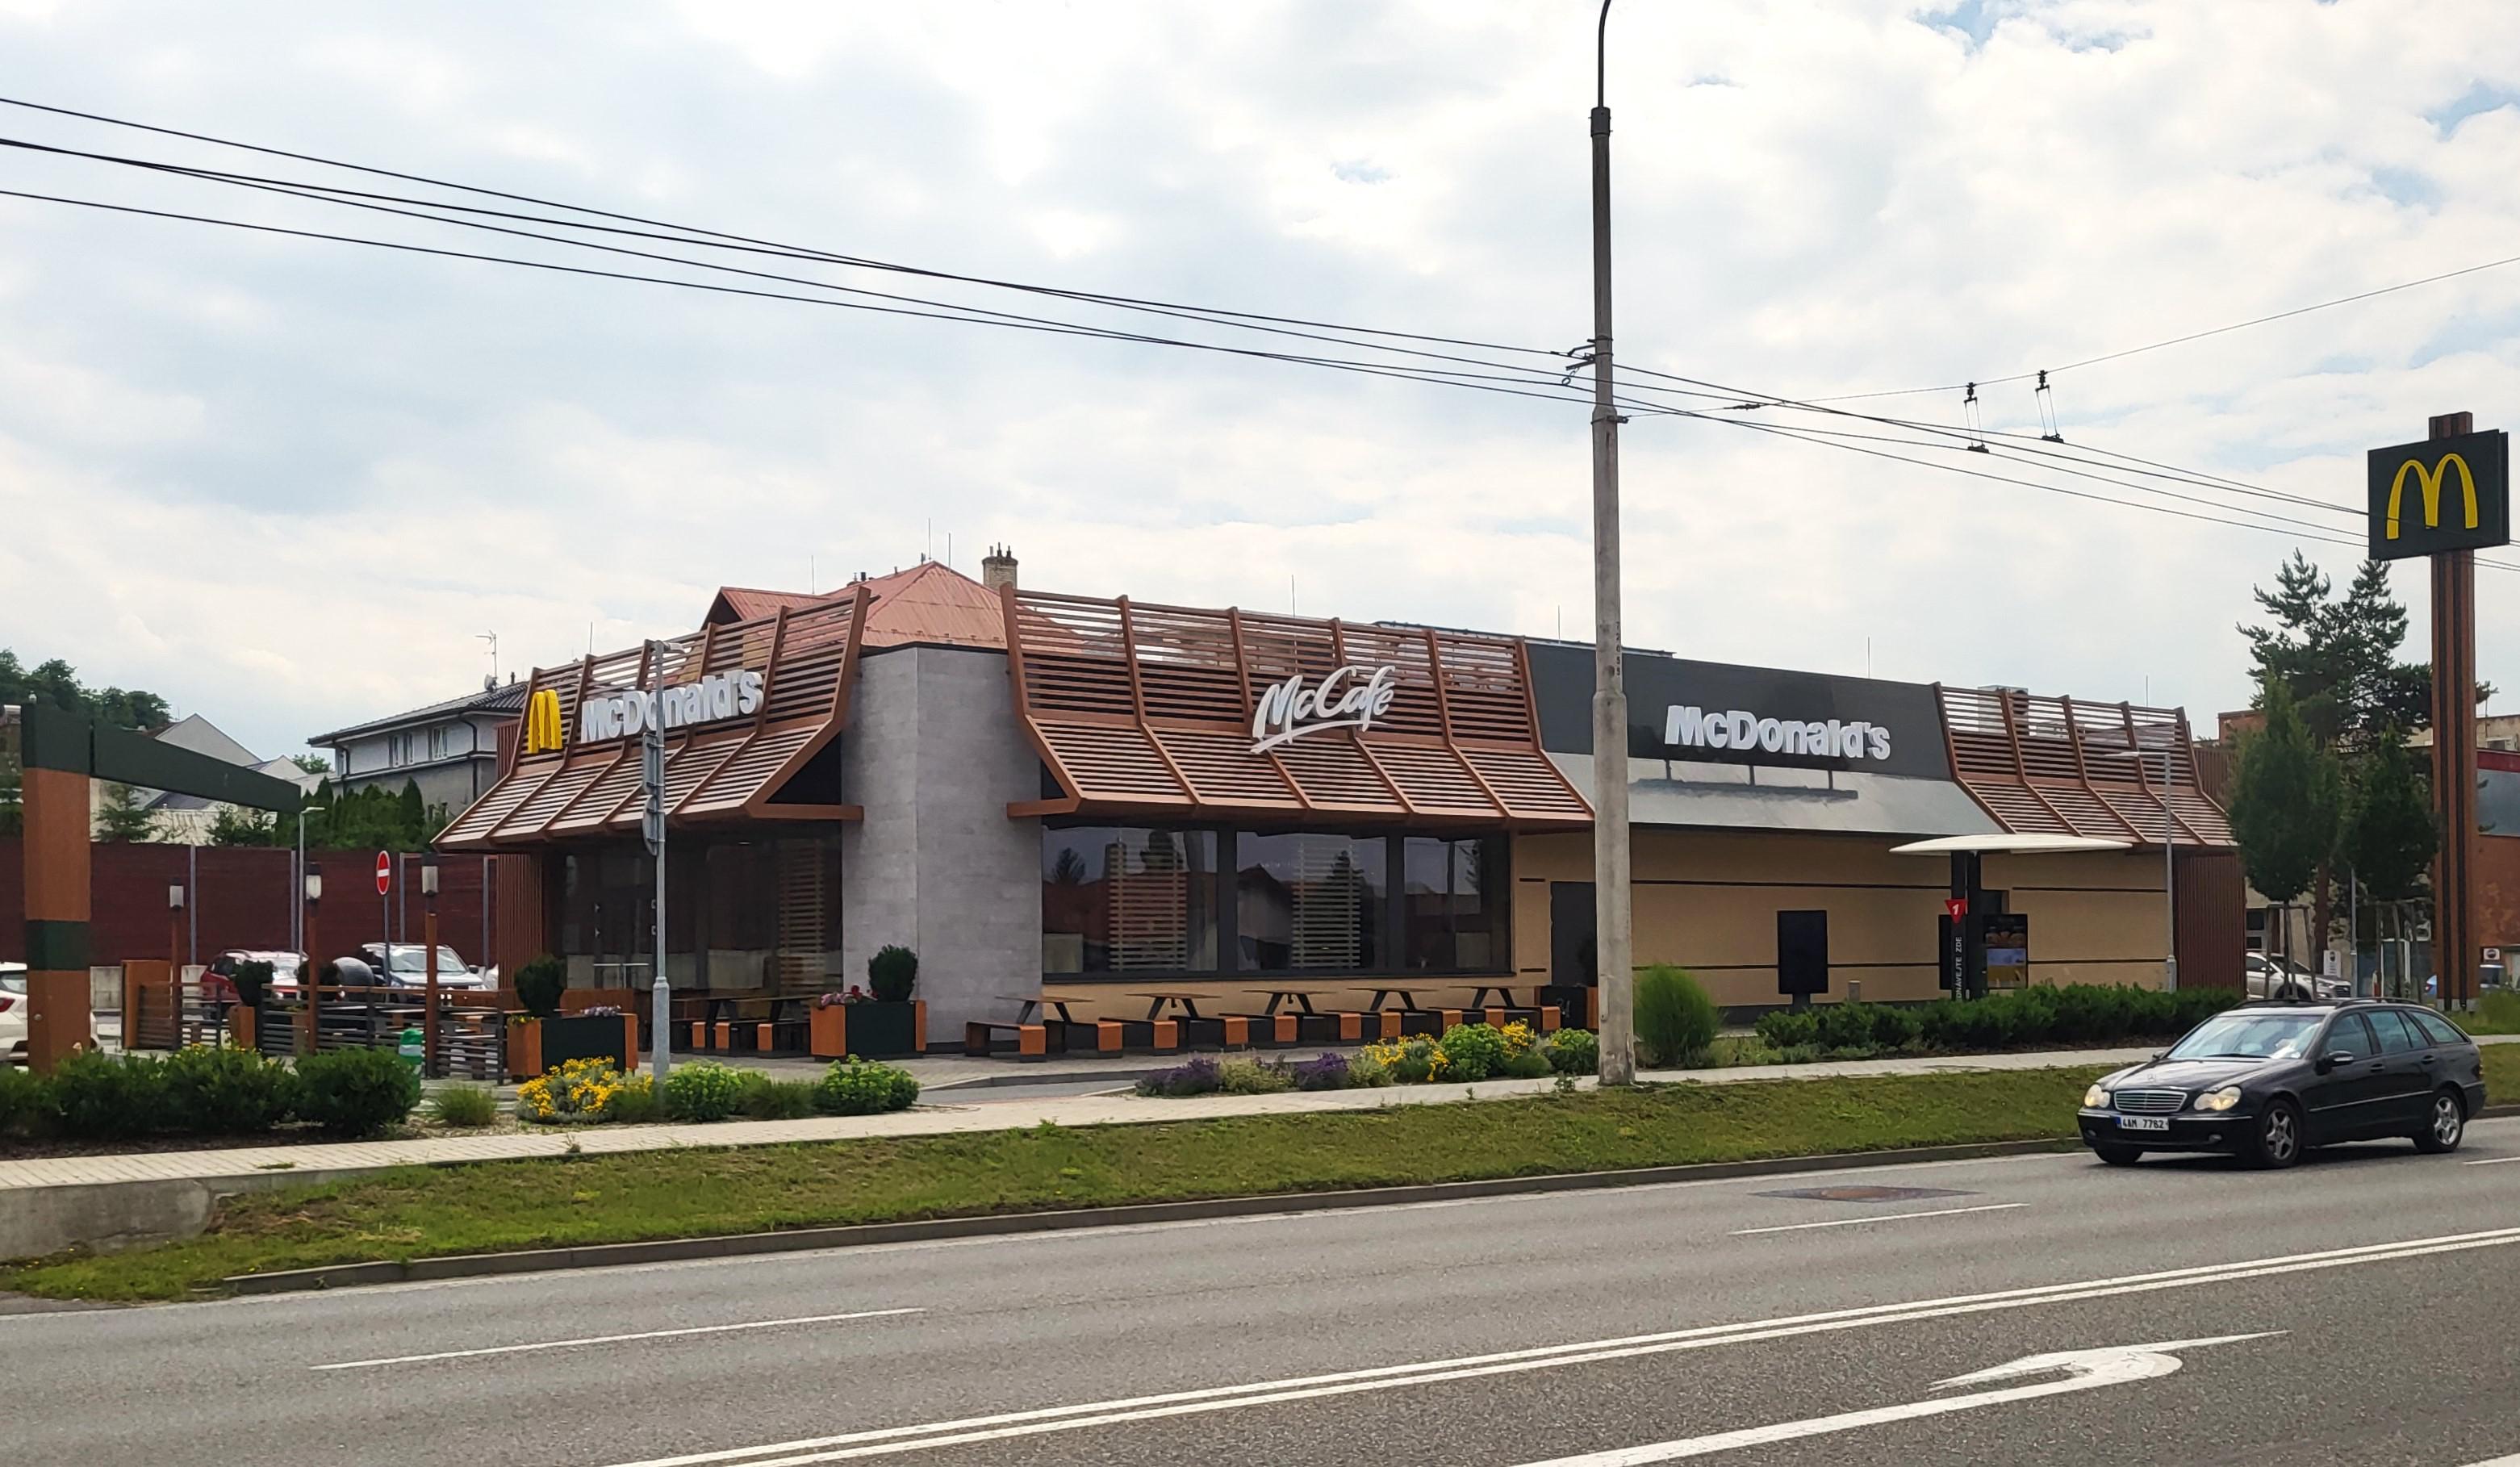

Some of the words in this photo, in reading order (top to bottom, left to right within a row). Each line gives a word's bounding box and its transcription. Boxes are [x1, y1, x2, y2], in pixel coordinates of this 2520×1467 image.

[581, 669, 763, 743] McDonald's
[1250, 665, 1395, 754] McCafé
[1665, 705, 1891, 760] McDonald's
[1953, 904, 1959, 915] 1
